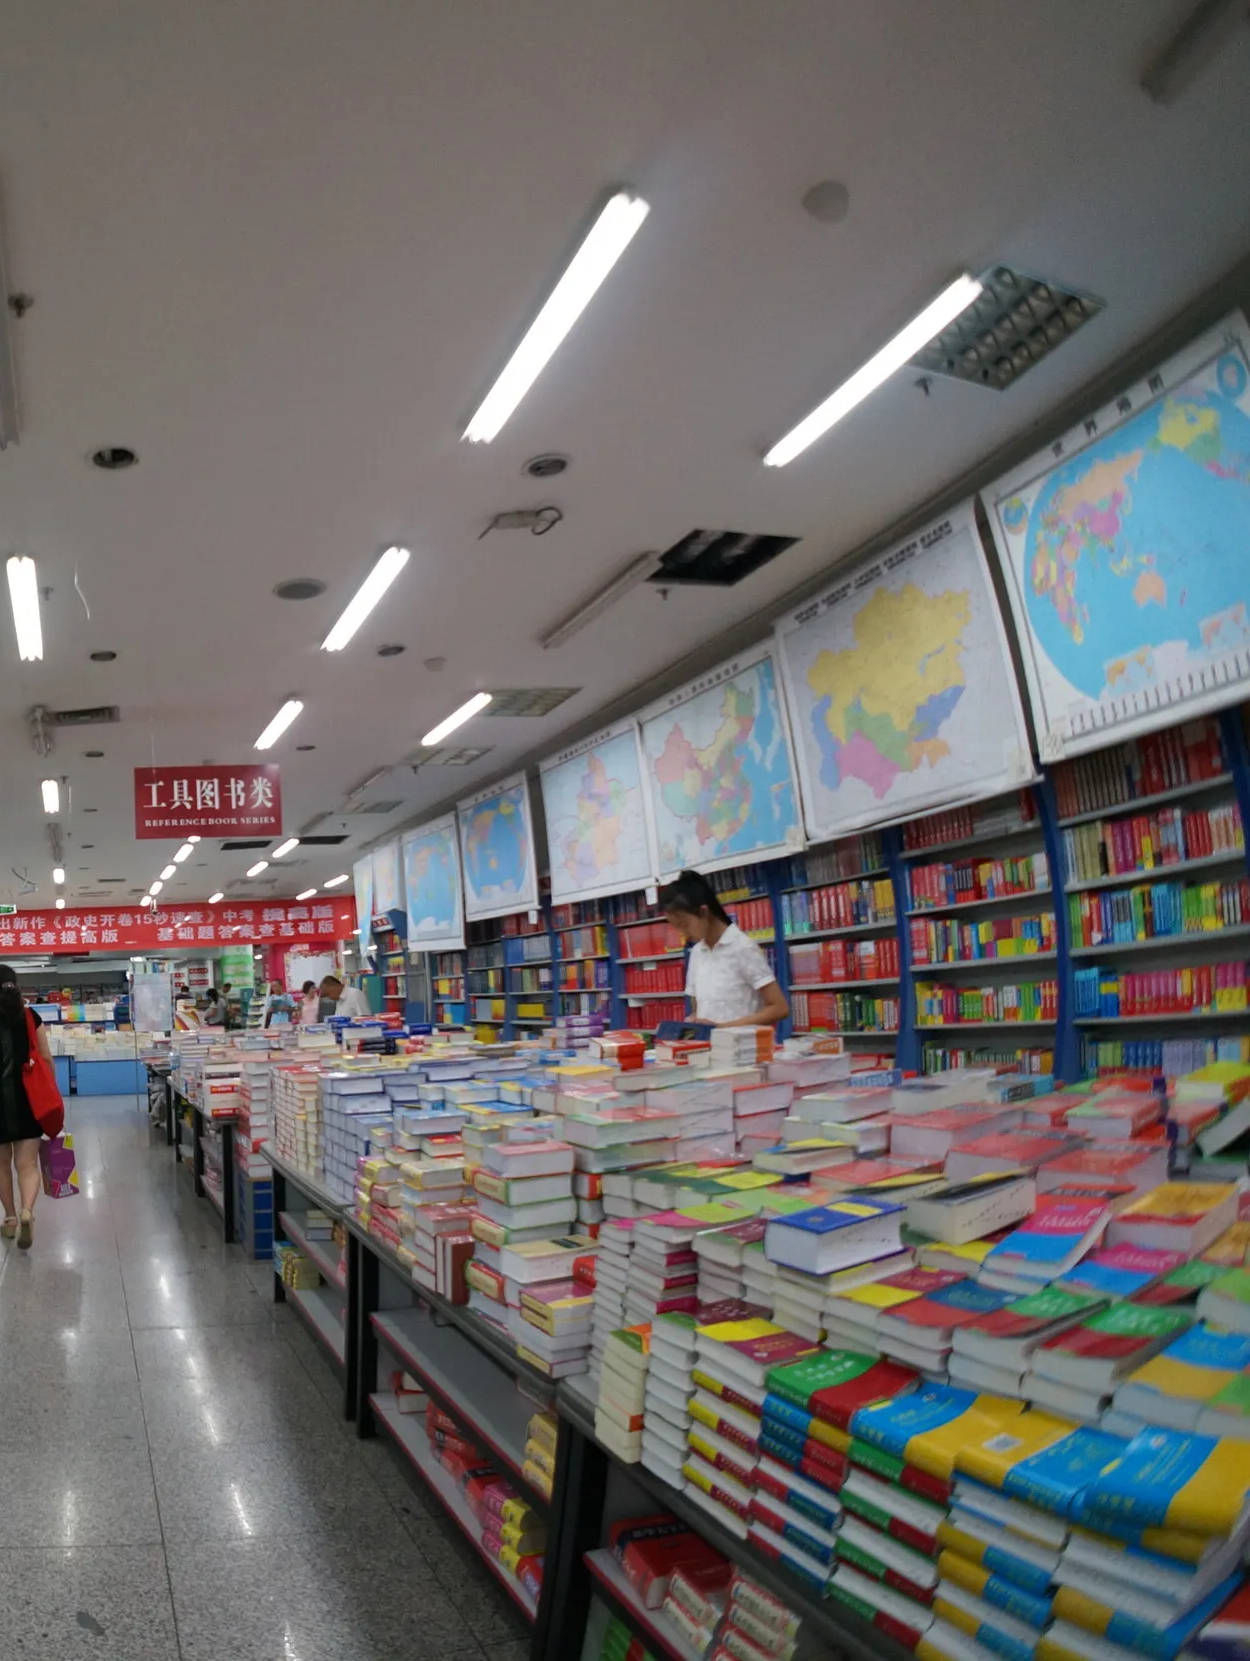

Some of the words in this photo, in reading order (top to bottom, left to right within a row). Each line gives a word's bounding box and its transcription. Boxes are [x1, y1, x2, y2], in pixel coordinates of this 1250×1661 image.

[143, 776, 274, 810] 工具图书类
[144, 818, 208, 827] REFERENCE
[208, 817, 238, 825] BOOK
[240, 816, 276, 824] SERIES
